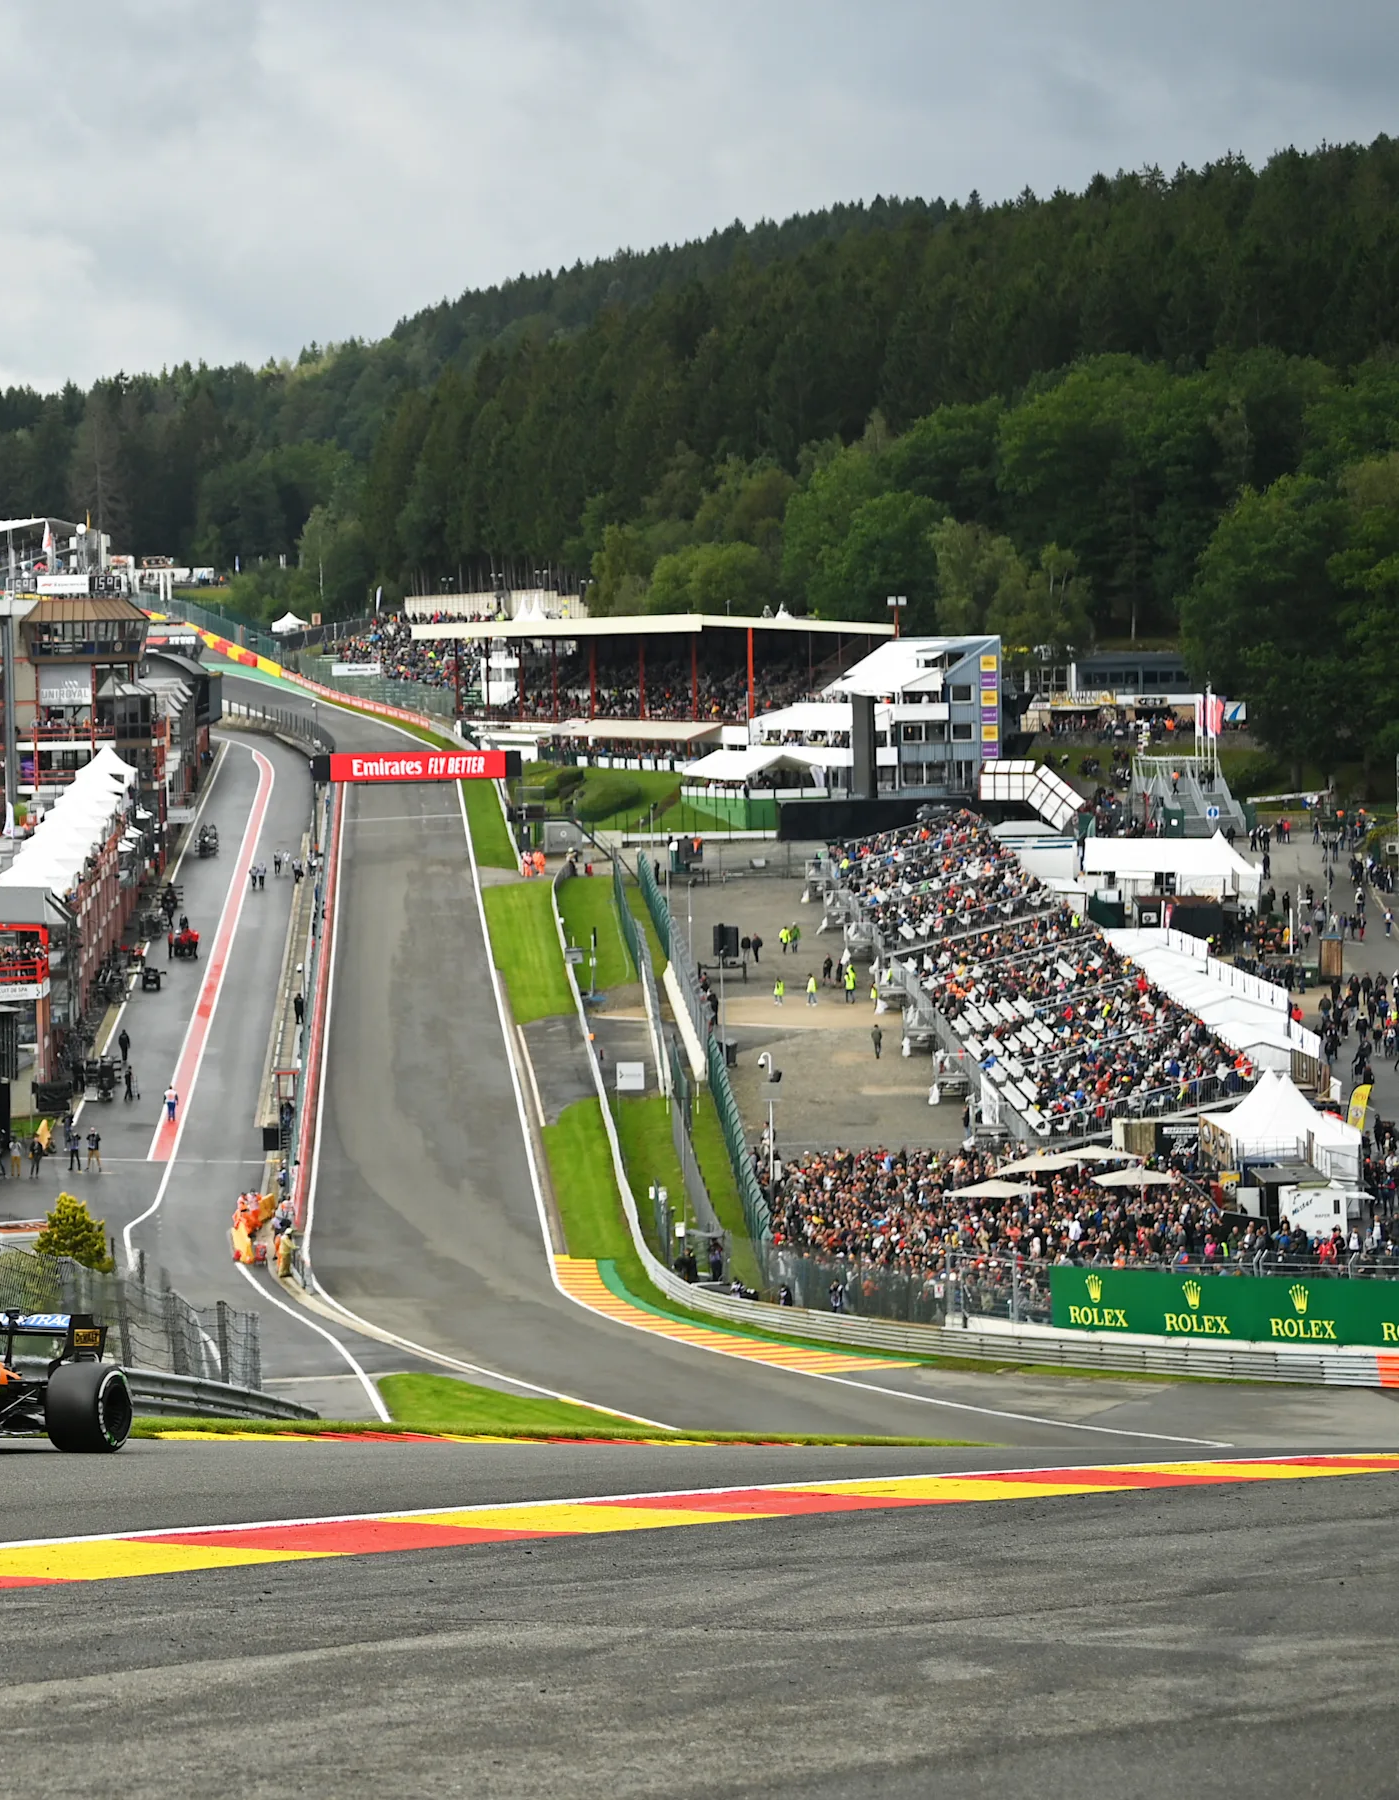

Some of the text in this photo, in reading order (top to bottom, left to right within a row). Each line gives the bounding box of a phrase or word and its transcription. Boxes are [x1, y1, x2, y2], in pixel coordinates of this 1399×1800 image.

[41, 688, 89, 699] UNIROYAL
[352, 756, 485, 776] Emirates FLY BETTER
[1068, 1305, 1129, 1327] ROLEX
[1164, 1313, 1231, 1334] ROLEX
[1270, 1318, 1337, 1339] ROLEX
[1380, 1322, 1399, 1342] R
